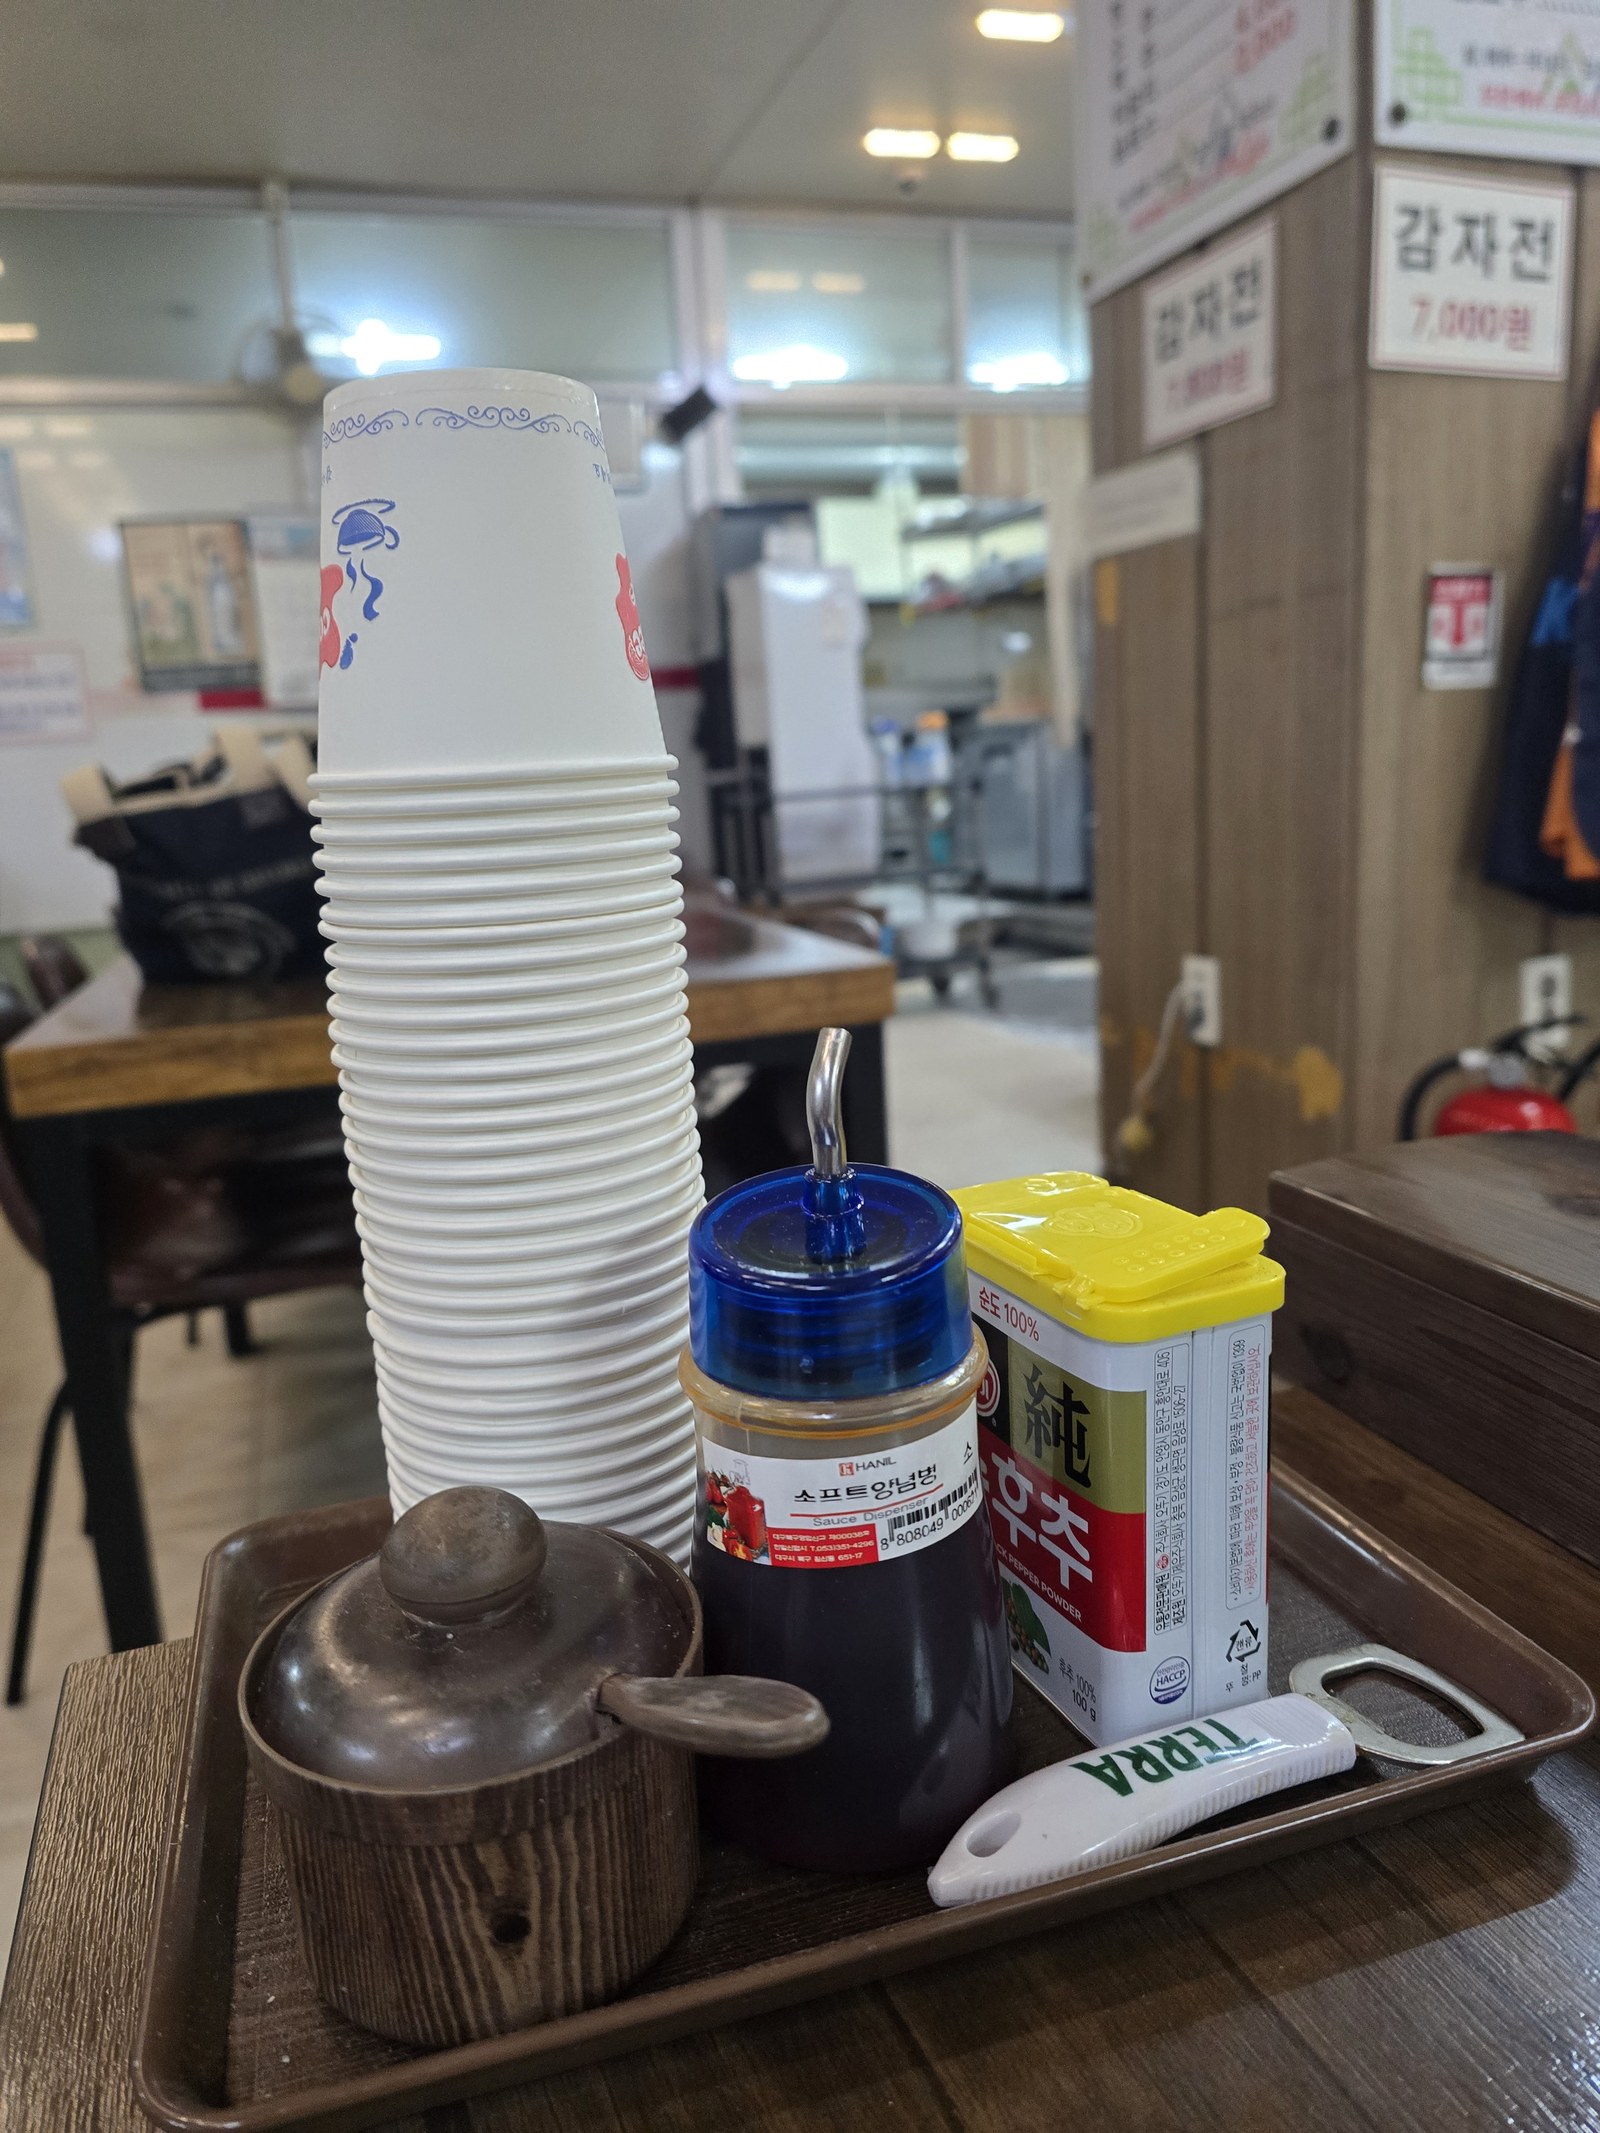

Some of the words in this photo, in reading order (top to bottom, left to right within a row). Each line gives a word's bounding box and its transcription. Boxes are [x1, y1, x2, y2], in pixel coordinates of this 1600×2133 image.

[1395, 203, 1554, 284] 감자전
[1410, 300, 1532, 352] 7,000원
[979, 1286, 1001, 1319] 순도
[1004, 1303, 1039, 1341] 100%
[1157, 1352, 1170, 1367] 405
[1232, 1339, 1245, 1358] 1399
[1156, 1369, 1171, 1405] 흥안대로
[1231, 1359, 1245, 1394] 국번없이
[1173, 1385, 1186, 1418] 1506-27
[1230, 1395, 1244, 1420] 신고는
[1024, 1363, 1091, 1488] 純
[1156, 1408, 1170, 1434] 동안구
[1172, 1419, 1186, 1446] 음성로
[1155, 1435, 1170, 1462] 안양시
[855, 1457, 897, 1472] HANIL
[1155, 1463, 1169, 1490] 경기도
[794, 1463, 936, 1503] 소프트양념병
[1172, 1476, 1186, 1502] 음성군
[813, 1516, 857, 1527] Sauce
[864, 1497, 928, 1523] Dispenser
[1155, 1491, 1169, 1517] 오뚜기
[880, 1538, 889, 1550] 8
[896, 1517, 944, 1546] 808049
[980, 1450, 1093, 1590] 후추
[1155, 1519, 1169, 1553] 주식회사
[1008, 1553, 1040, 1588] PEPPER
[1041, 1581, 1082, 1622] POWDER
[1171, 1599, 1186, 1626] 제조원
[1076, 1674, 1097, 1703] 100%
[1156, 1669, 1186, 1687] HACCP
[1073, 1689, 1088, 1712] 100
[1090, 1708, 1097, 1722] g
[1068, 1718, 1264, 1797] TERRA
